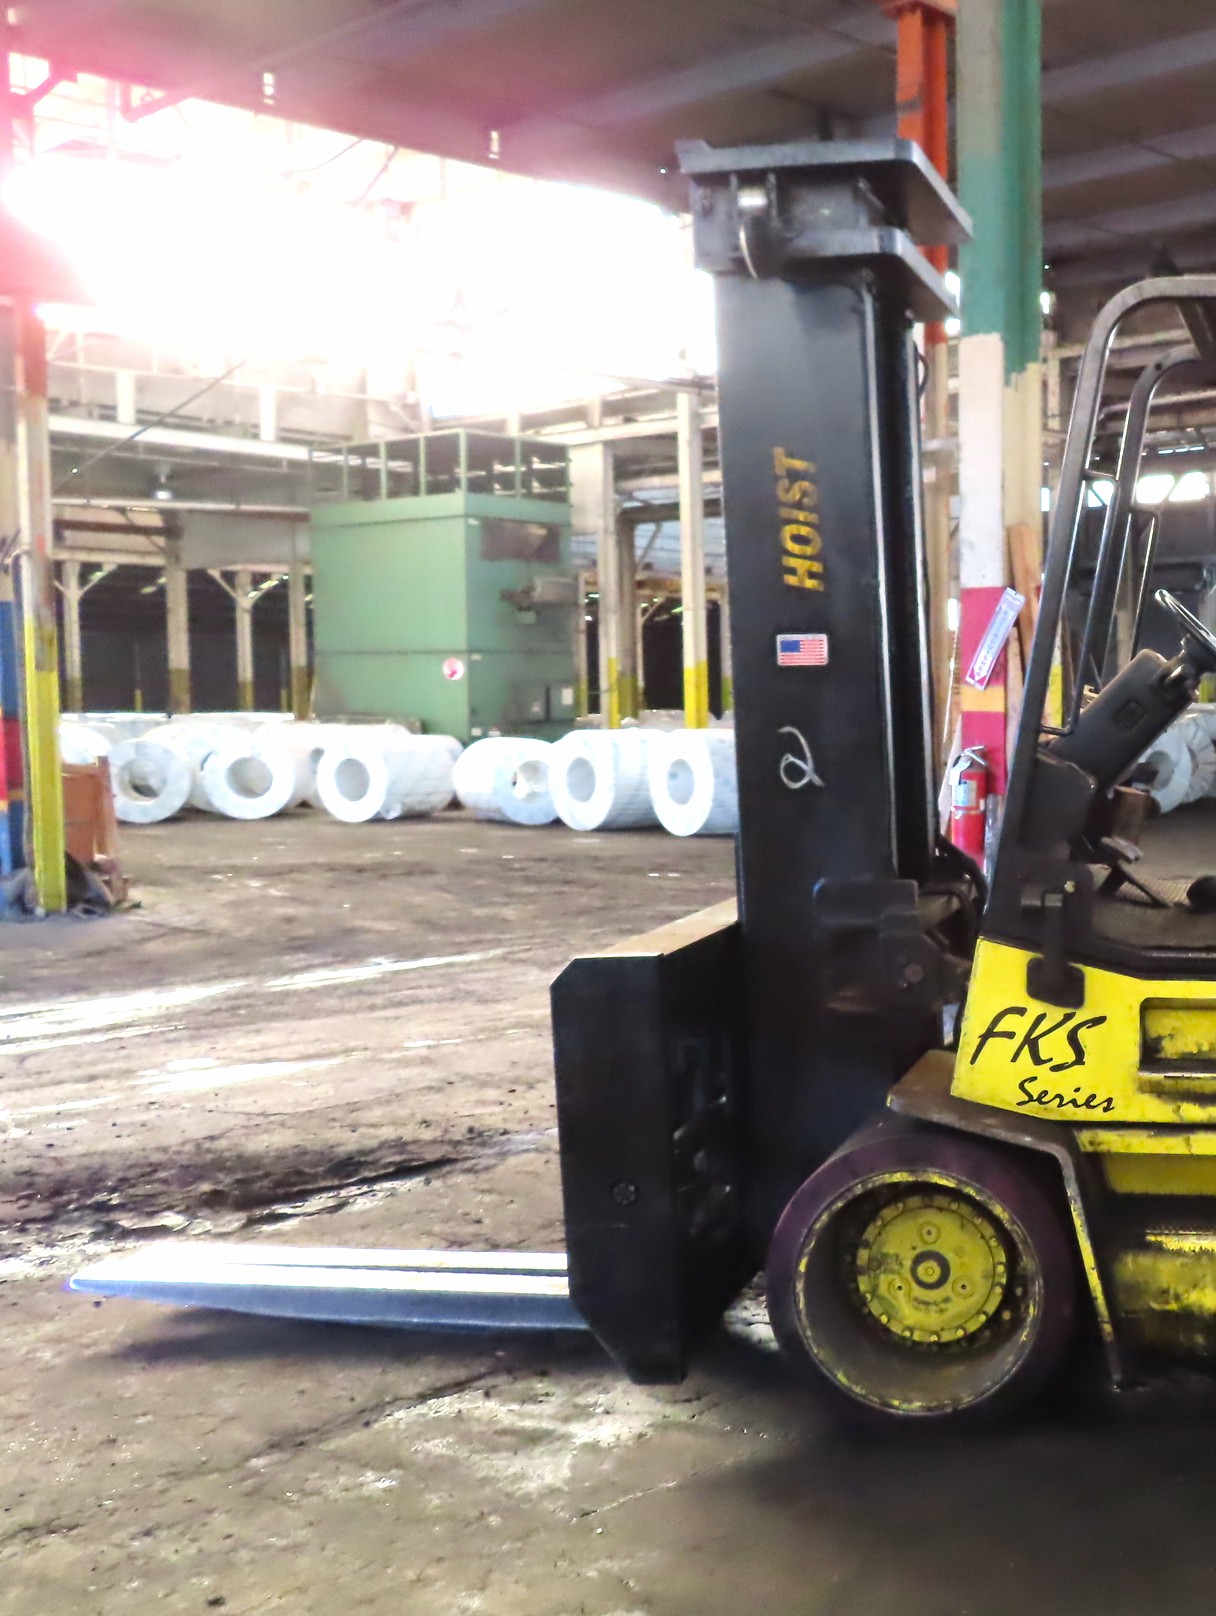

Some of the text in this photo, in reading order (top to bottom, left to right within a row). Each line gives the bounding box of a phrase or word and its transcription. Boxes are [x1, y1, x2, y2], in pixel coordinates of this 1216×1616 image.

[773, 446, 825, 592] HOIST
[970, 1005, 1108, 1073] FKS
[1015, 1076, 1115, 1113] Series
